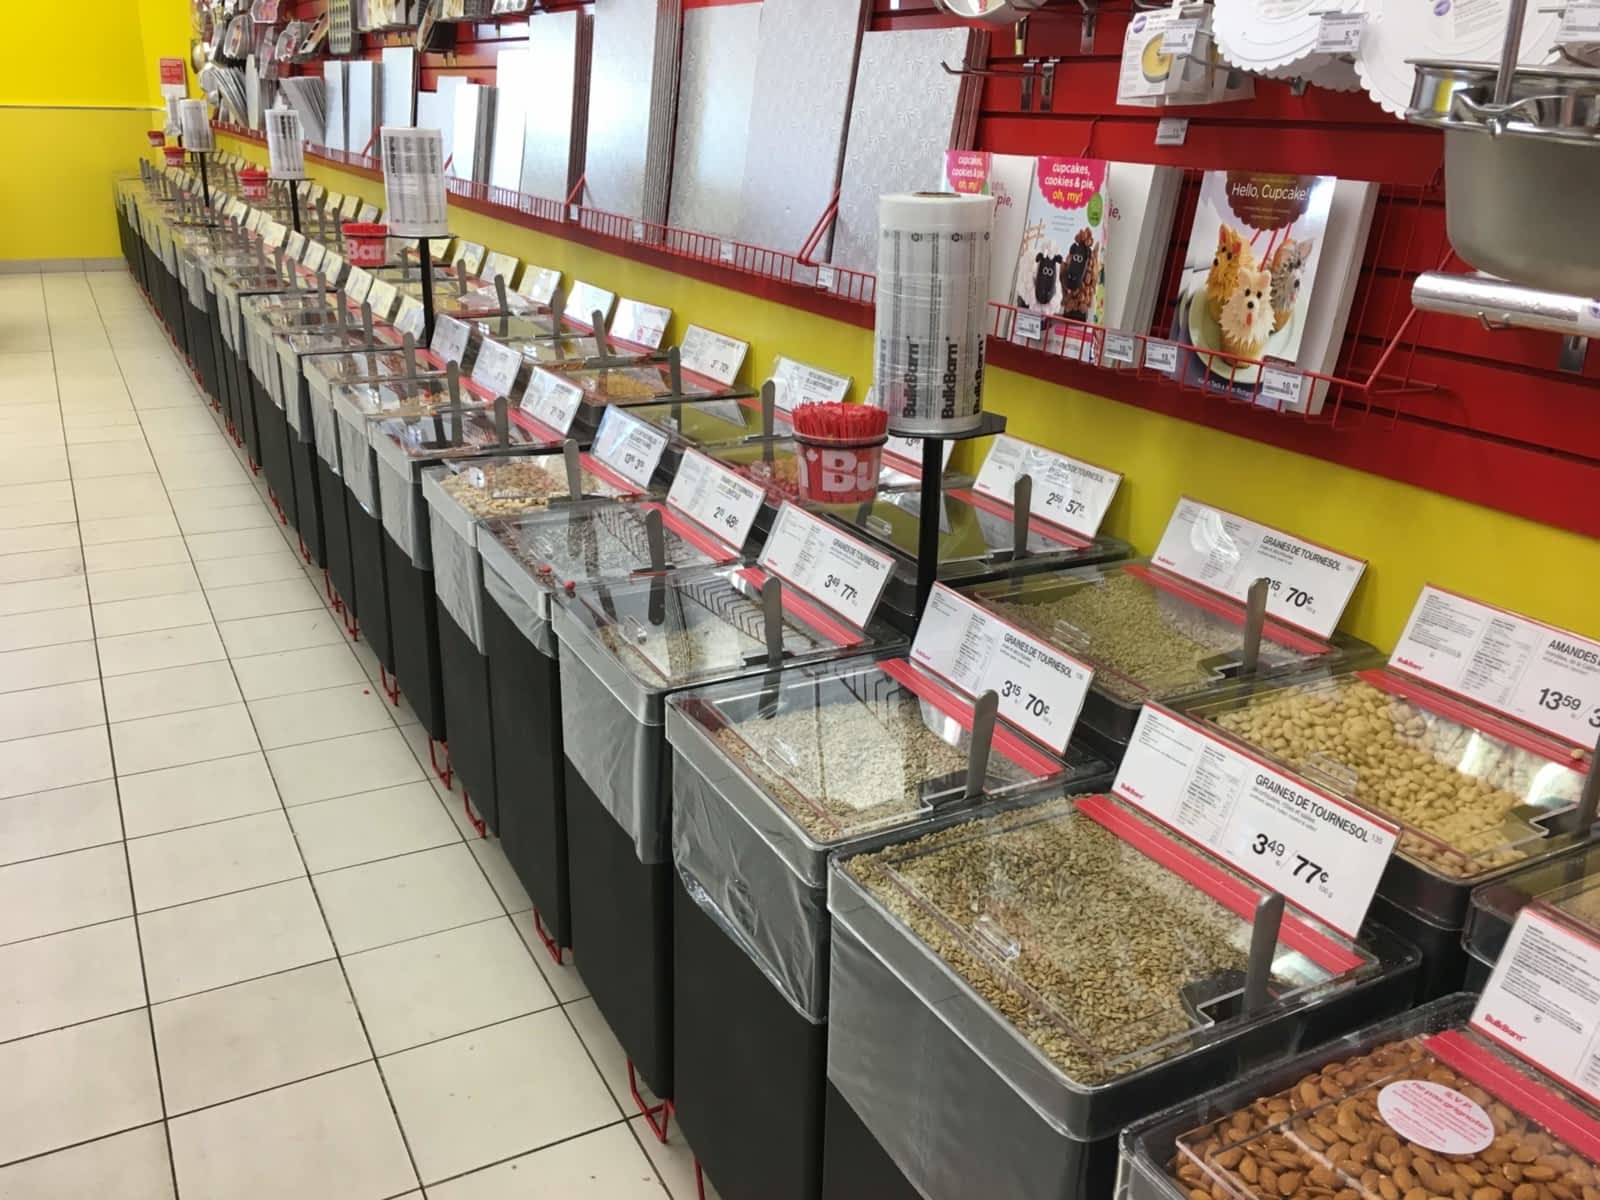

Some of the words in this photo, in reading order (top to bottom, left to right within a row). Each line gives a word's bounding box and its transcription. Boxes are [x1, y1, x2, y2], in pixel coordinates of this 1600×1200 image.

[1044, 175, 1074, 188] cookies
[1073, 177, 1080, 188] &
[1081, 179, 1095, 191] pie,
[1052, 162, 1090, 176] cupcakes,
[1052, 189, 1065, 201] oh,
[1067, 191, 1083, 204] my!
[1231, 183, 1259, 199] Hello,
[1261, 184, 1309, 201] Cupcake!
[902, 335, 920, 418] BulkBarn
[941, 336, 958, 419] BulkBarn
[1262, 535, 1291, 554] GRAINES
[1291, 544, 1301, 556] DE
[1300, 547, 1341, 571] TOURNESOL
[1286, 587, 1314, 607] 70¢
[1003, 633, 1029, 654] GRAINES
[1028, 646, 1037, 658] DE
[1036, 651, 1072, 679] TOURNESOL
[1548, 640, 1599, 663] AMANDES
[1001, 680, 1022, 698] 315
[1025, 694, 1050, 717] 70¢
[1538, 688, 1581, 711] 1359
[1255, 774, 1296, 802] GRAINES
[1295, 795, 1308, 810] DE
[1310, 799, 1369, 843] TOURNESOL
[1252, 833, 1285, 857] 349
[1292, 855, 1329, 884] 77¢
